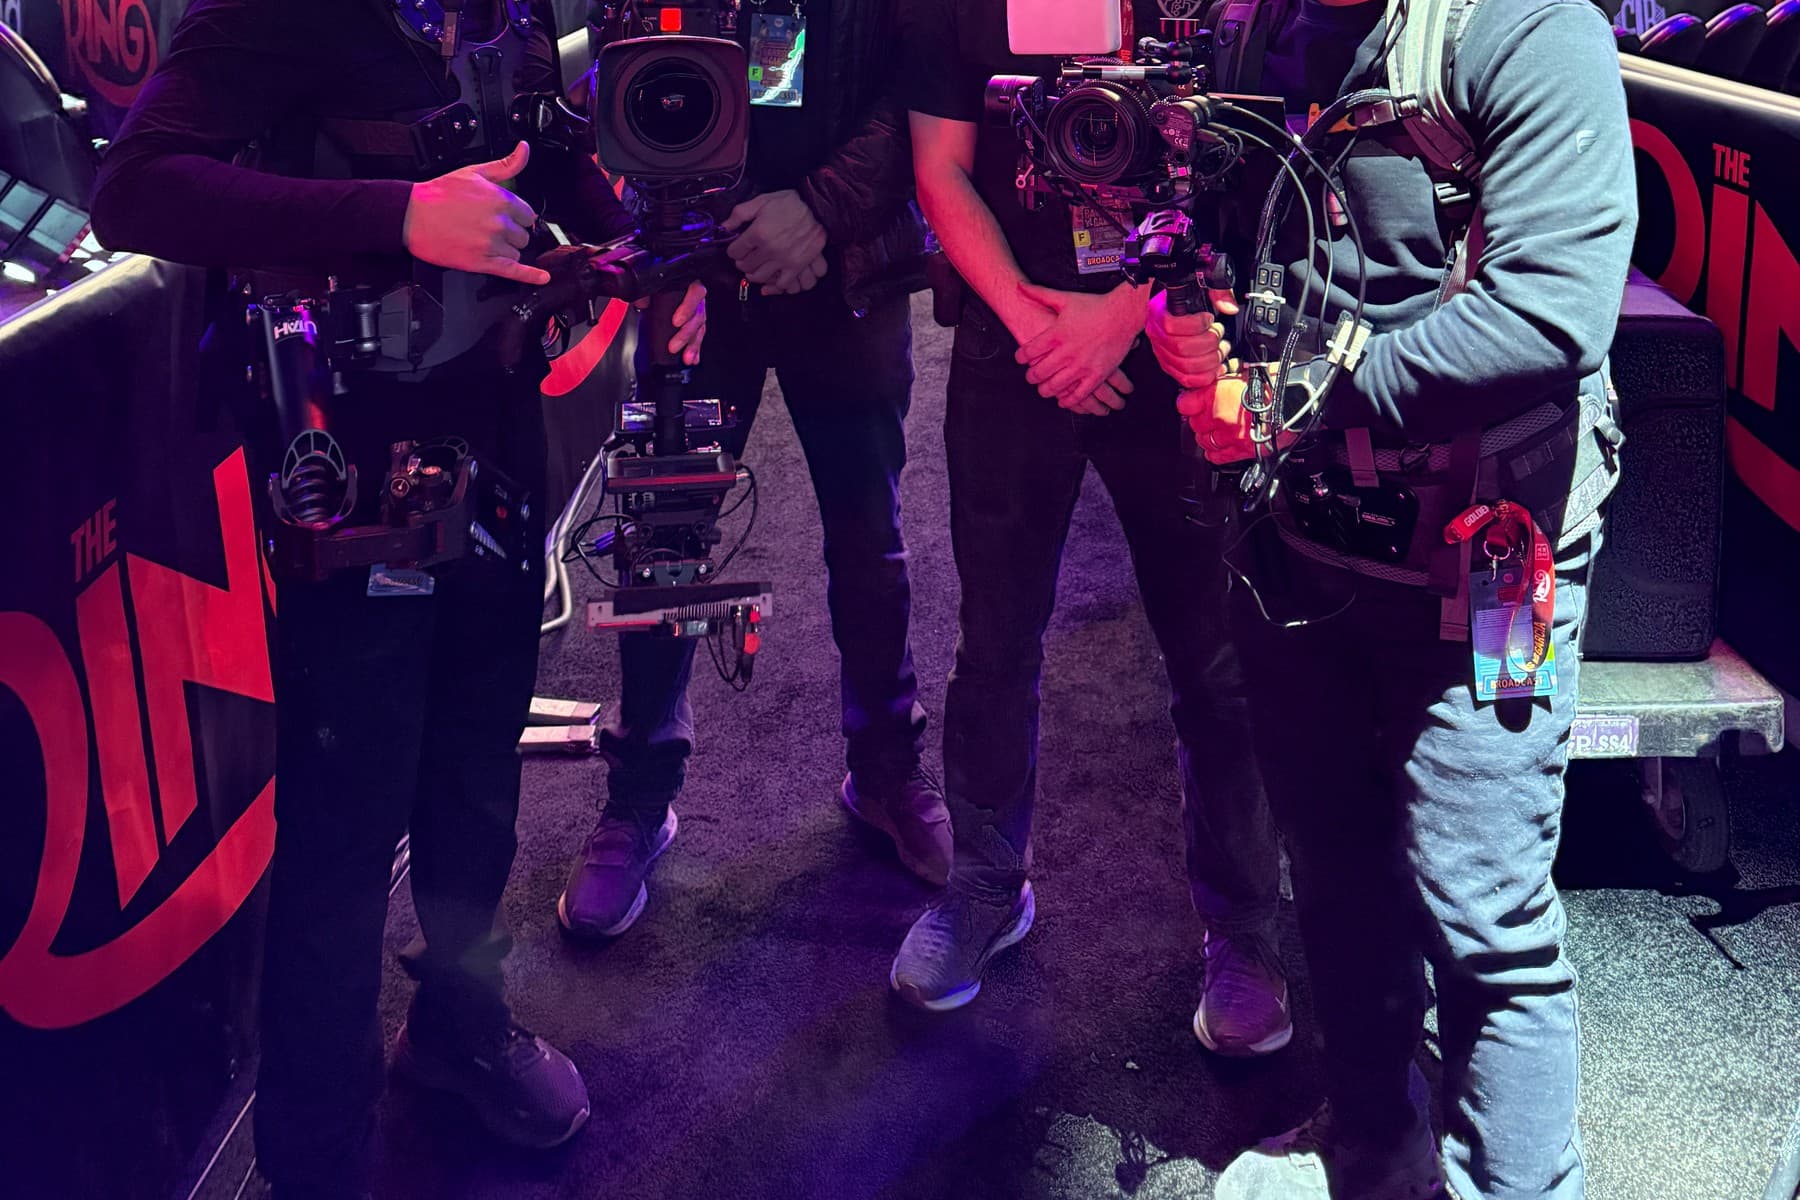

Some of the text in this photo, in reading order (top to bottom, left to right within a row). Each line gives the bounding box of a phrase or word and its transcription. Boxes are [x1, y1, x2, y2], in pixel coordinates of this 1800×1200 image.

[1712, 142, 1751, 188] THE
[273, 319, 318, 340] UTAH
[70, 497, 119, 583] THE
[1490, 676, 1545, 690] BROADCAST
